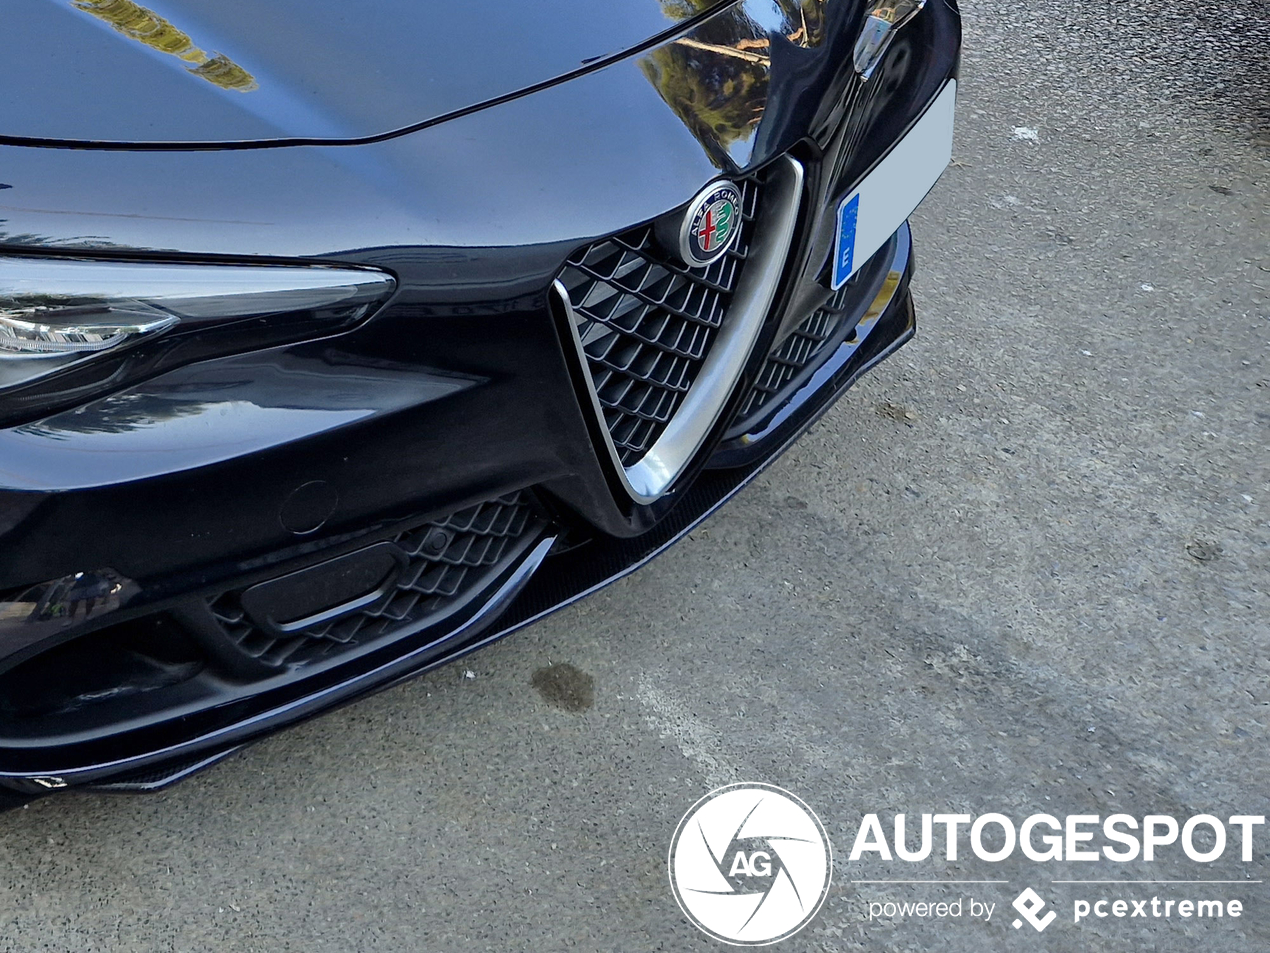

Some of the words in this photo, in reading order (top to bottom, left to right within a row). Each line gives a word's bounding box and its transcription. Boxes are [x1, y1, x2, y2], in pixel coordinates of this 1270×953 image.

[691, 201, 710, 236] ALFA
[714, 190, 740, 216] ROMEO
[842, 247, 850, 268] E
